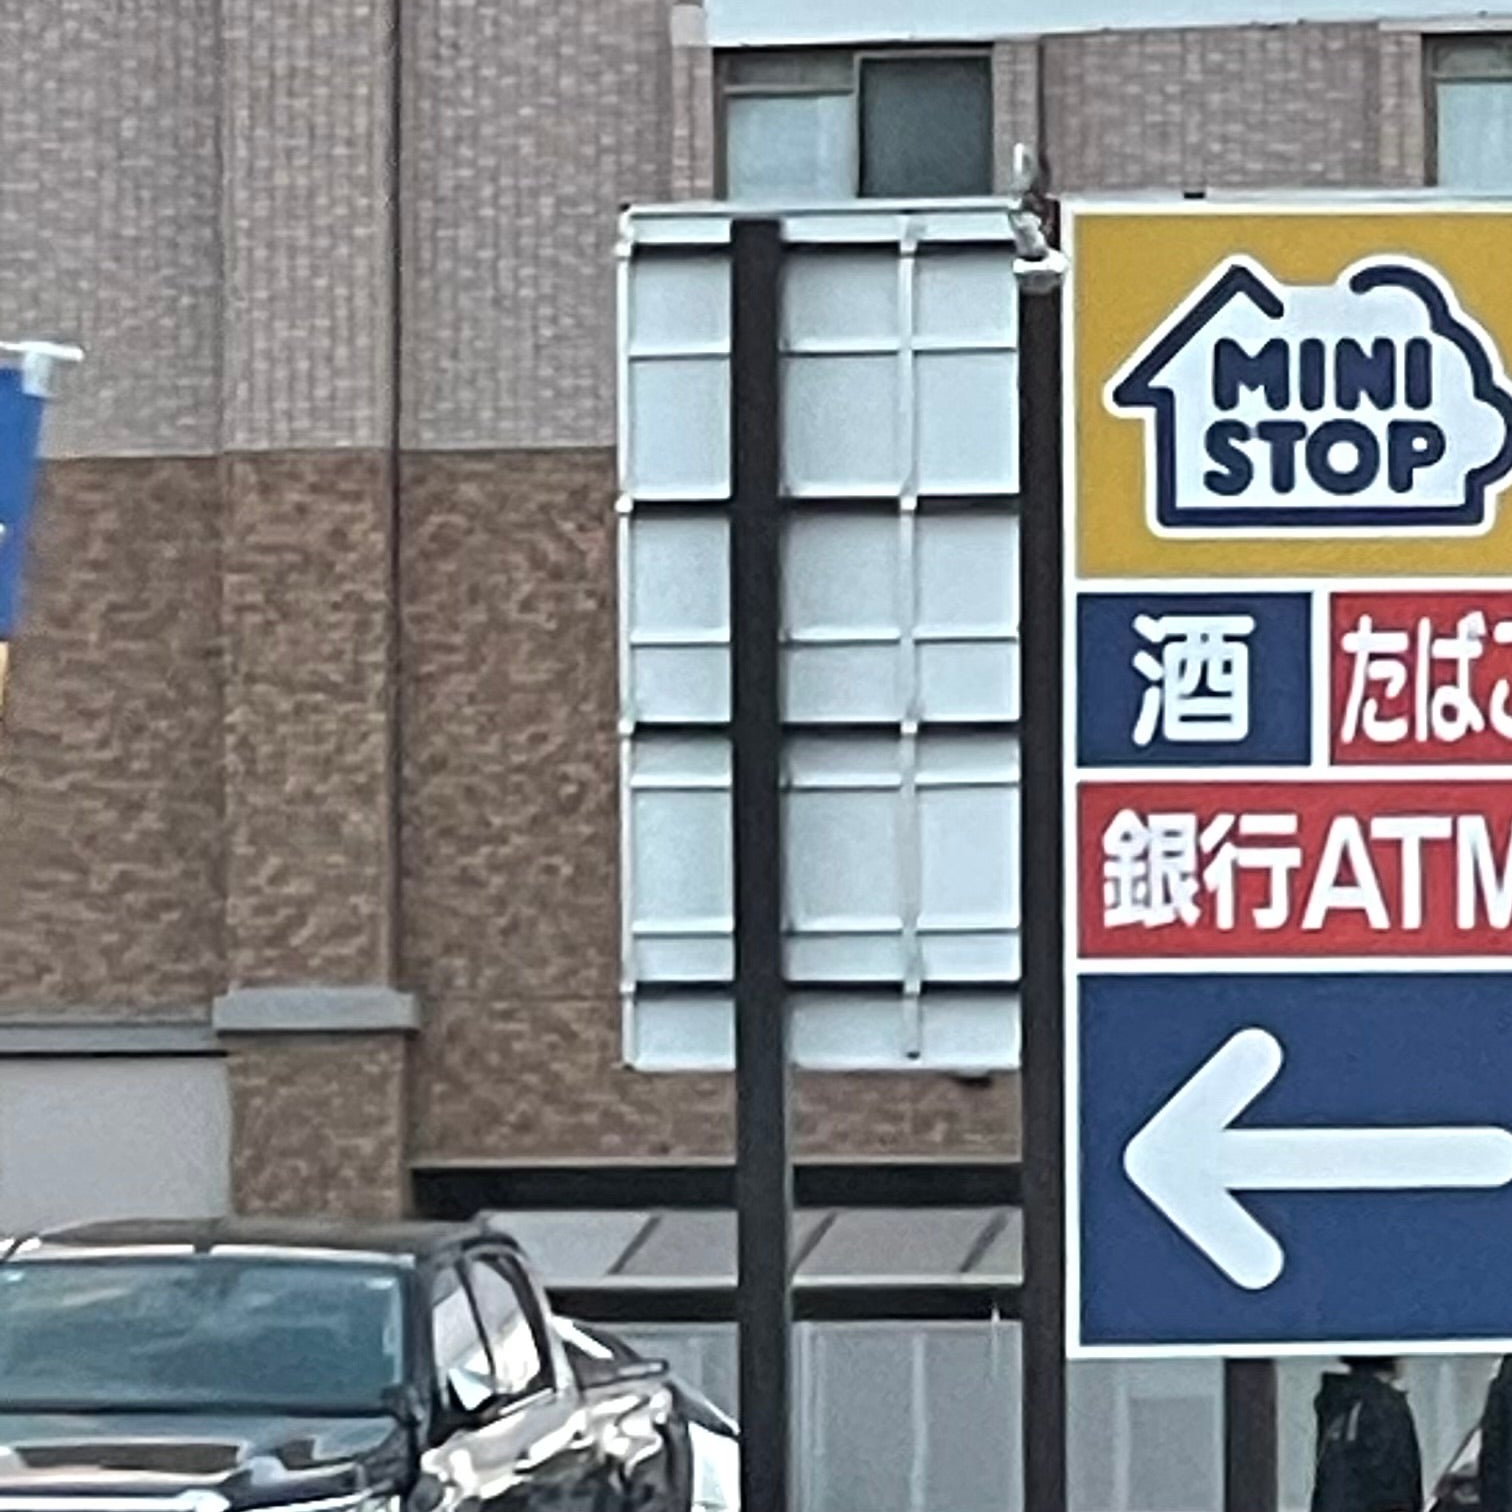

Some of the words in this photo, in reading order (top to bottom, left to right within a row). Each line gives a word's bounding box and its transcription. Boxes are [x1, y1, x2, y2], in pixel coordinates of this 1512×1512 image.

[1213, 338, 1433, 410] MINI
[1204, 418, 1446, 495] STOP
[1133, 614, 1255, 746] 酒
